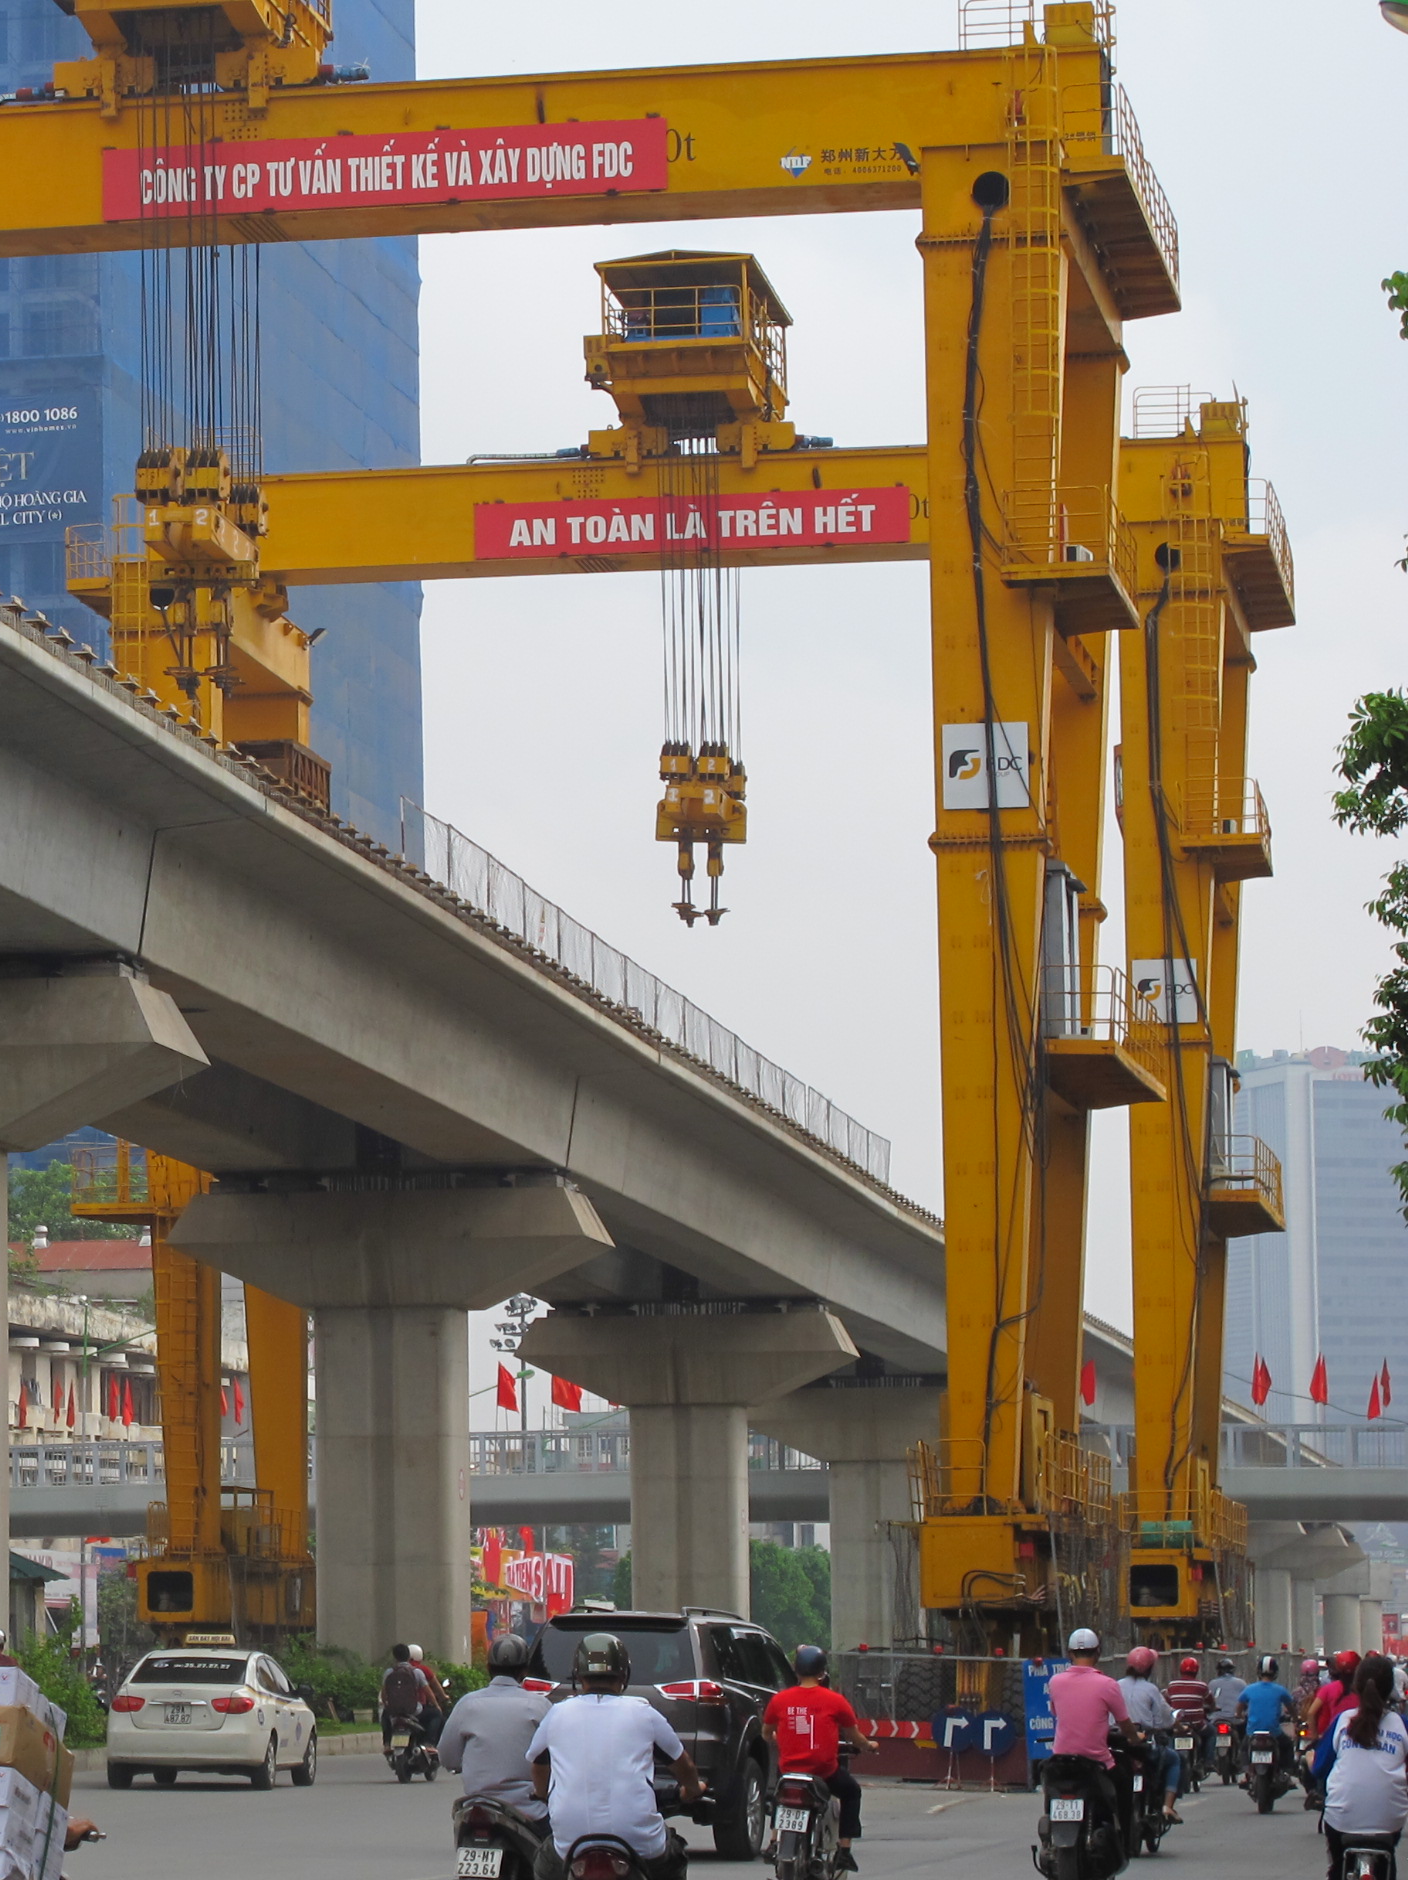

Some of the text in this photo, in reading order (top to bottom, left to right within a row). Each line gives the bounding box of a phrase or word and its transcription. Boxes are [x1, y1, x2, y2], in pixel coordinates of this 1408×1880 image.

[140, 137, 633, 204] CÔNG TY CP TƯ VẤN THIẾT KẾ VÀ XÂY DỰNG FDC
[44, 406, 78, 421] 1086
[5, 424, 77, 434] www.vinhomes.vn
[14, 491, 61, 507] HOÀNG
[63, 490, 87, 504] GIA
[13, 510, 46, 525] CITY
[149, 508, 208, 526] 1 2
[510, 493, 876, 547] AN TOÀN LÀ TRÊN HẾT
[1030, 1715, 1054, 1729] CÔNG
[458, 1863, 496, 1876] 223.64
